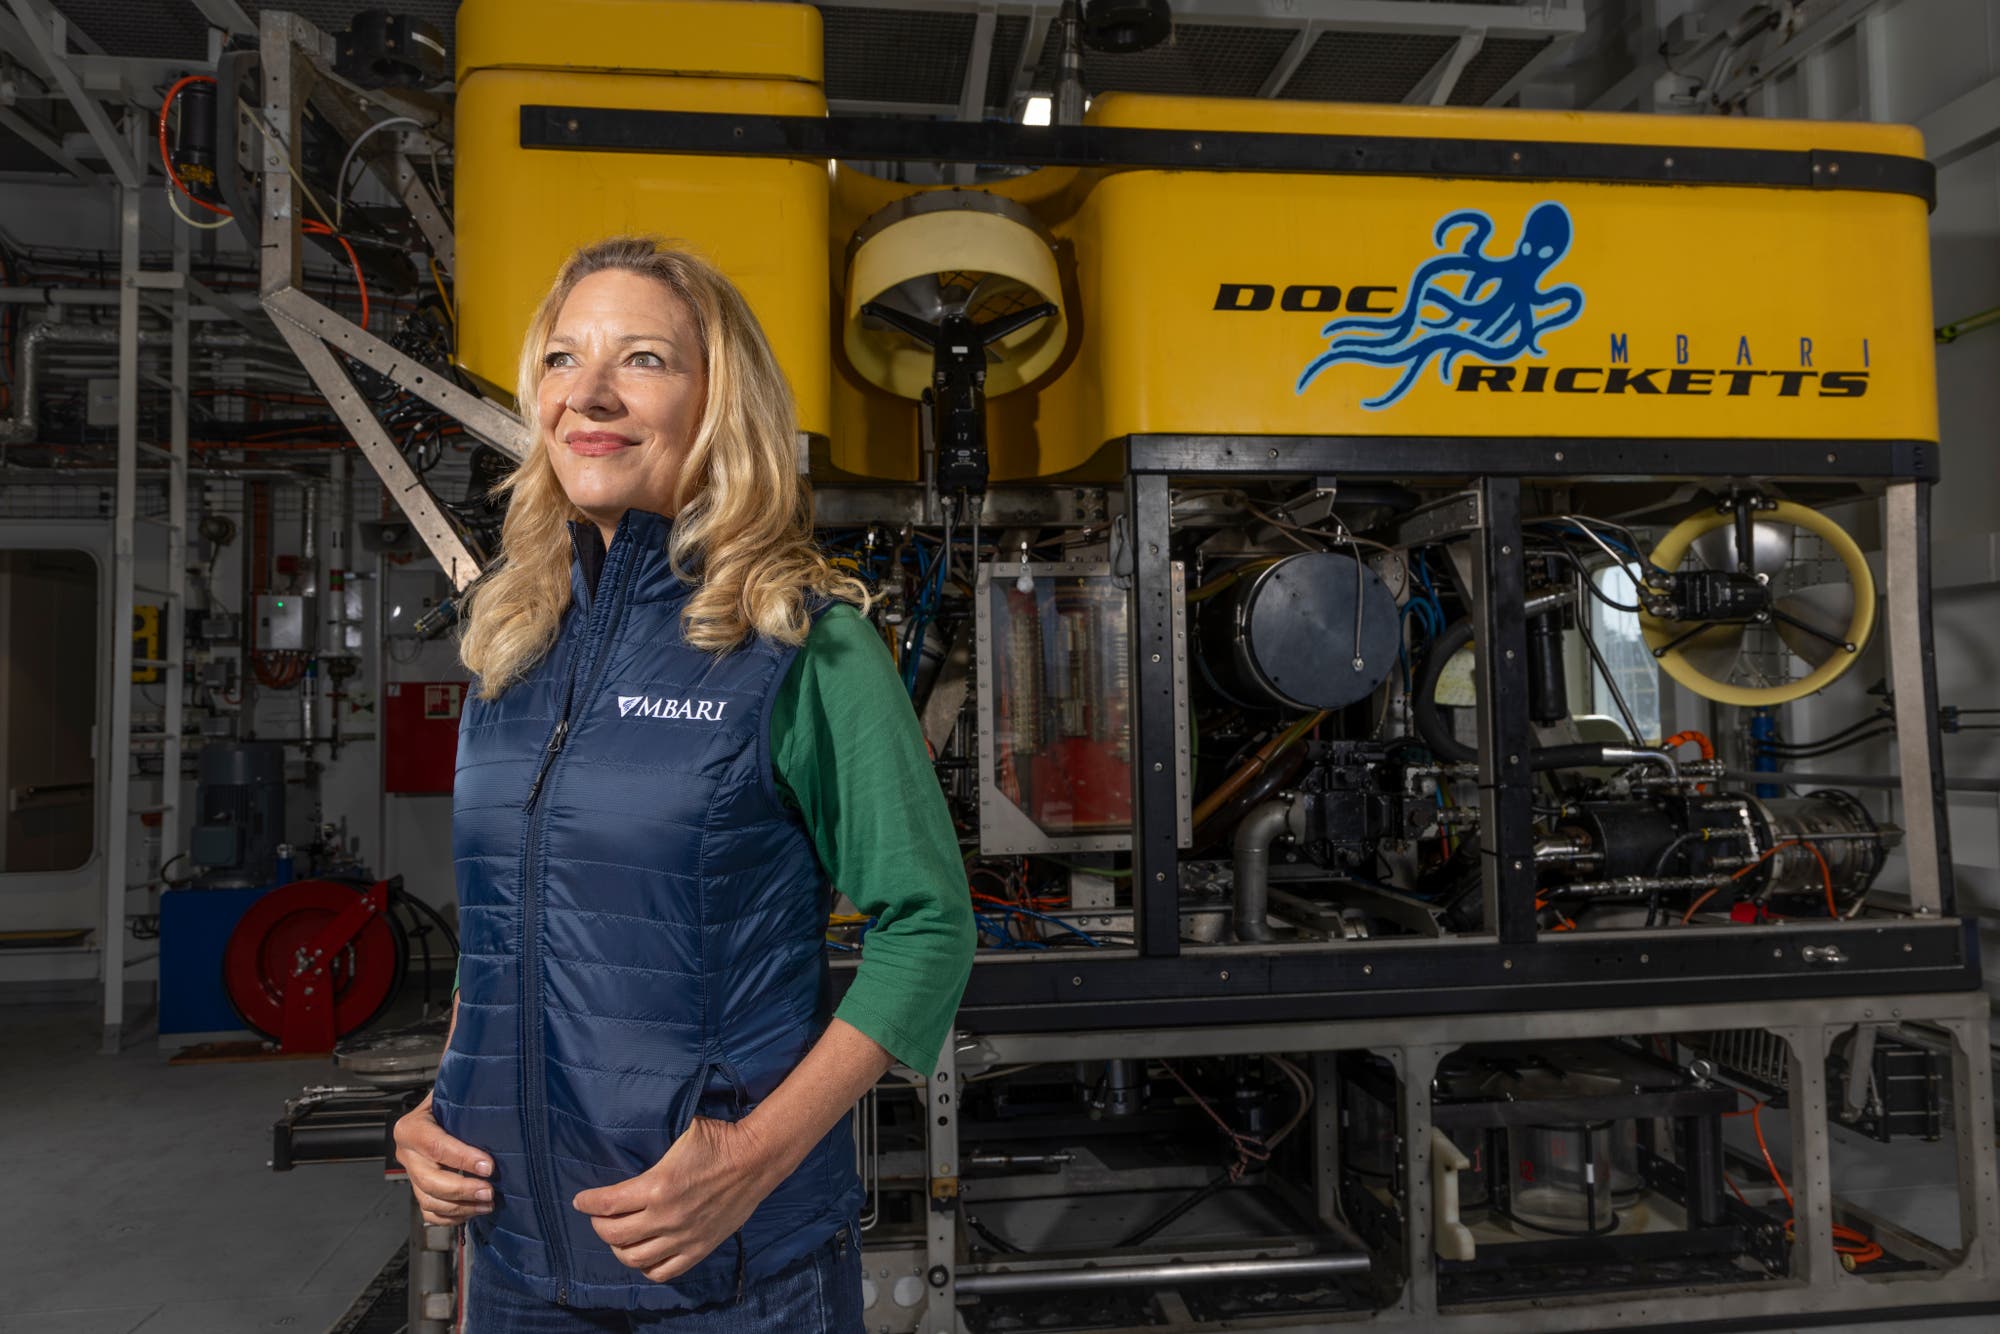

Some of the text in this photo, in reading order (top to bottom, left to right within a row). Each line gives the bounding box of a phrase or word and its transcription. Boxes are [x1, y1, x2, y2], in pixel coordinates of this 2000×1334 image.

[1213, 283, 1398, 314] DOC
[1610, 333, 1870, 368] MBARI
[1456, 365, 1870, 397] RICKETTS
[634, 696, 728, 721] MBARI
